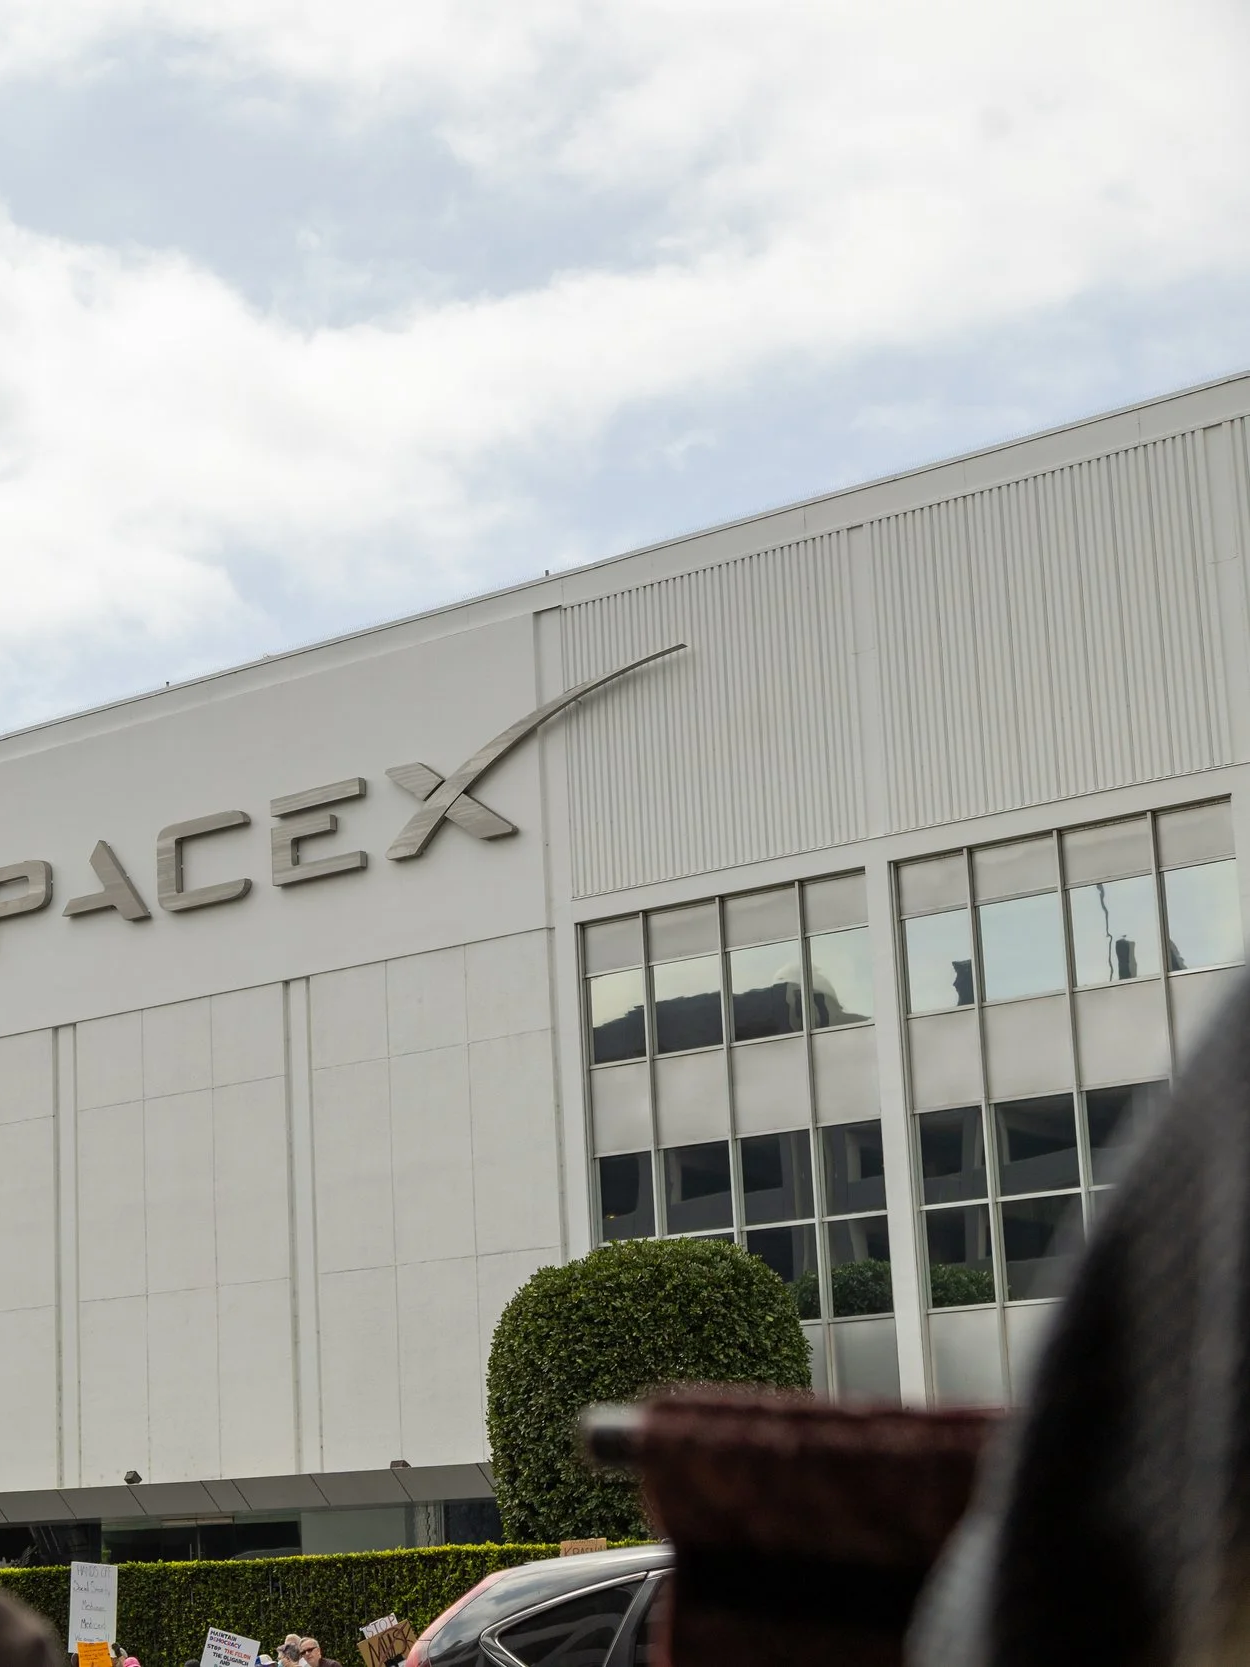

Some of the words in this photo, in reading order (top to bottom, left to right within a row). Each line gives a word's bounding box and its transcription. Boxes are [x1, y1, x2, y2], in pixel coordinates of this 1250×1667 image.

[365, 1614, 395, 1637] STOP
[210, 1630, 237, 1641] MAINTAIN
[206, 1643, 221, 1651] STOP
[209, 1635, 241, 1649] DEMOCRACY
